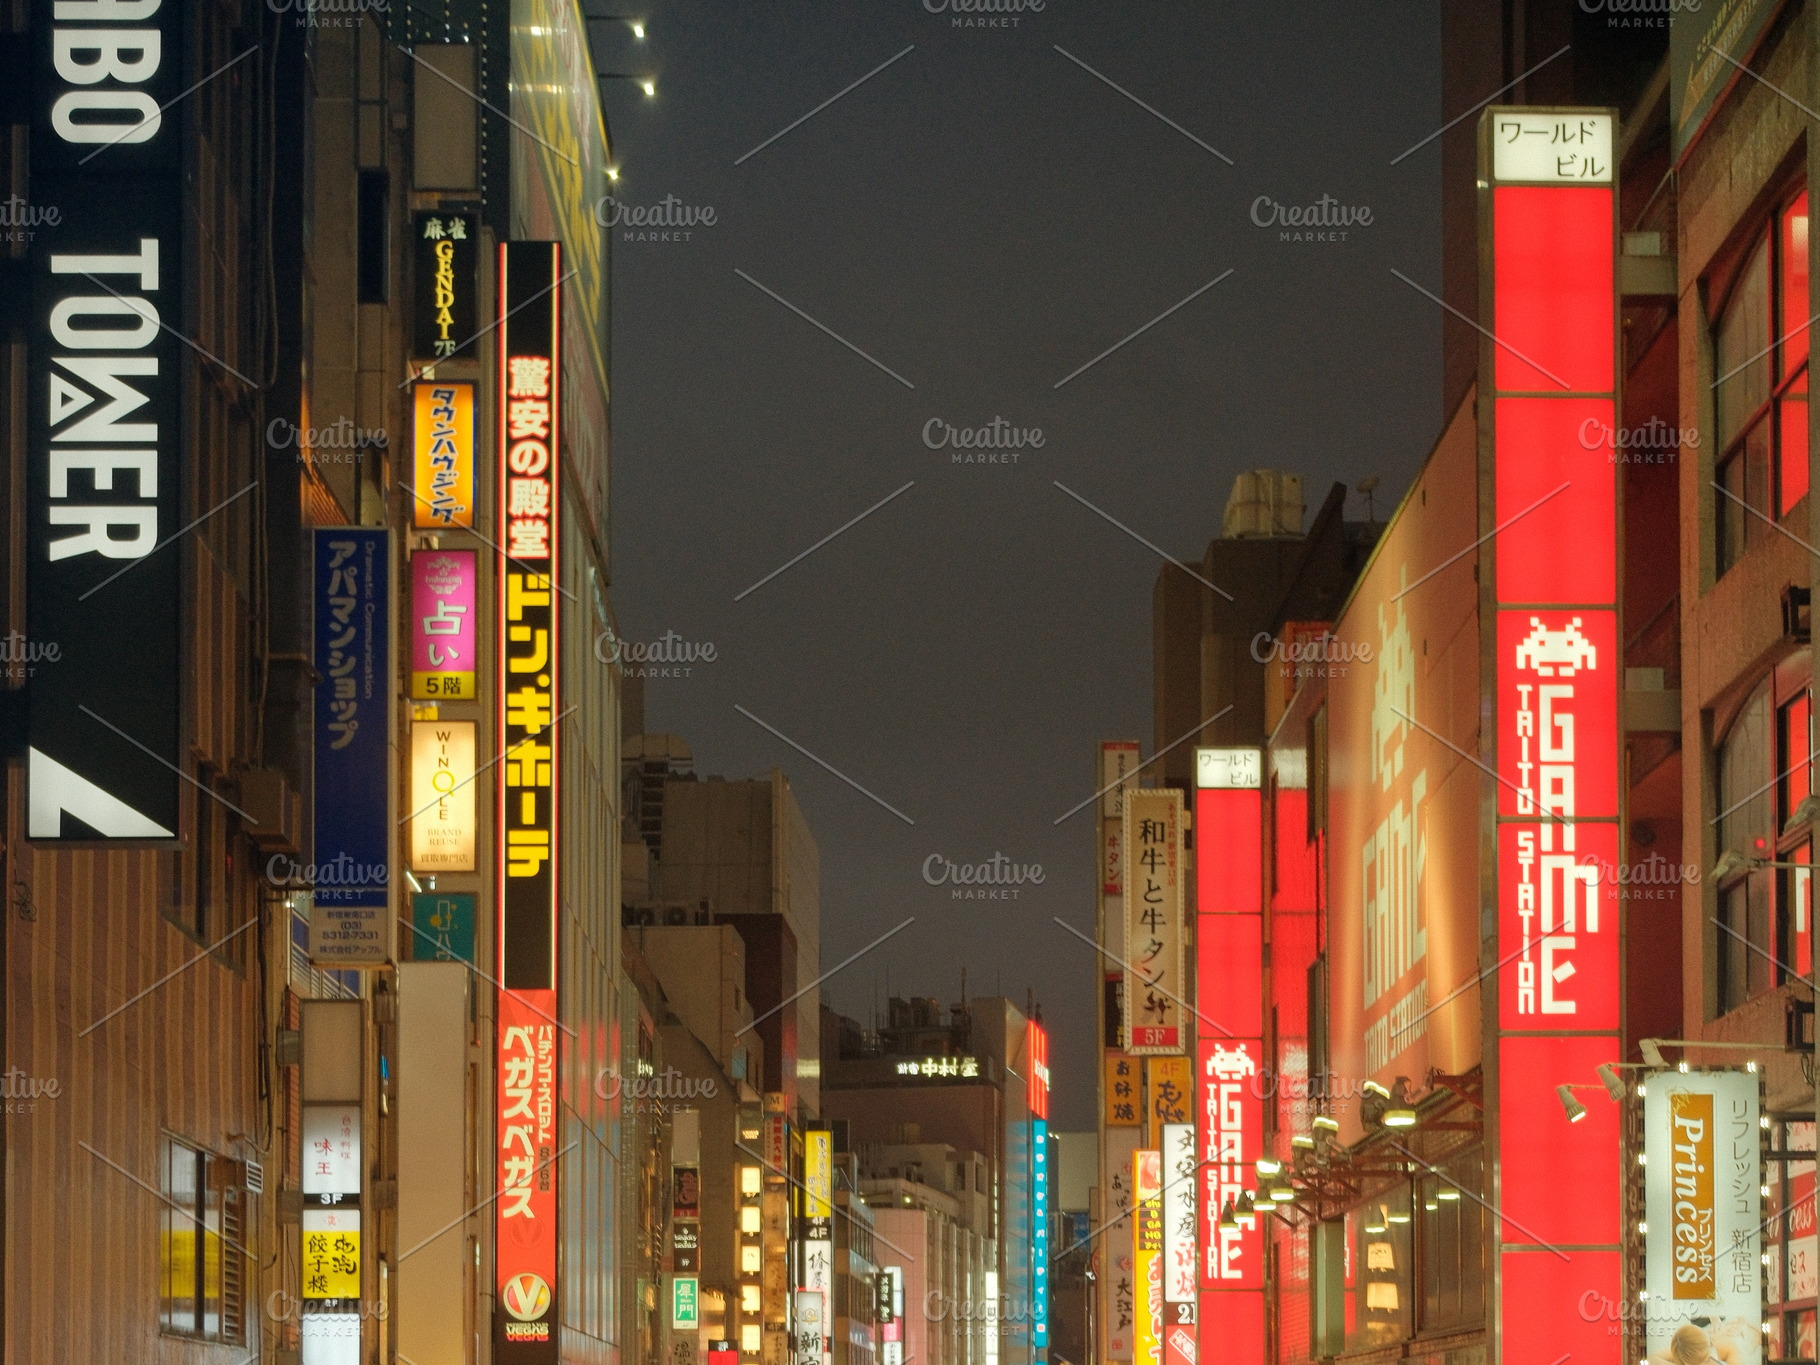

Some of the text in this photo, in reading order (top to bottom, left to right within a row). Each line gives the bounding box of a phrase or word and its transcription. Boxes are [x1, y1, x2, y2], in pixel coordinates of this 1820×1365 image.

[1500, 121, 1596, 146] ワールド
[1555, 155, 1606, 178] ビル
[423, 217, 467, 240] 麻雀
[435, 241, 454, 340] GENDAI
[49, 238, 160, 562] TOWER
[430, 388, 464, 524] タウンハウジング
[508, 355, 551, 559] 驚安の殿堂
[328, 541, 358, 750] アパマンショップ
[422, 600, 468, 667] 占い
[1199, 752, 1252, 767] ワールド
[1516, 684, 1535, 1014] TAITO STATION
[1539, 684, 1600, 1014] GAME
[1138, 818, 1168, 985] 和牛と牛タン
[1144, 1028, 1166, 1045] 5F
[314, 1138, 333, 1176] 味王
[503, 1026, 535, 1219] ベガスベガス
[320, 1193, 343, 1205] 3F
[809, 1227, 828, 1239] 4F
[1675, 1115, 1704, 1284] Princess
[1697, 1207, 1713, 1283] プリンセス
[1730, 1101, 1753, 1294] リフレッシュ 新宿店
